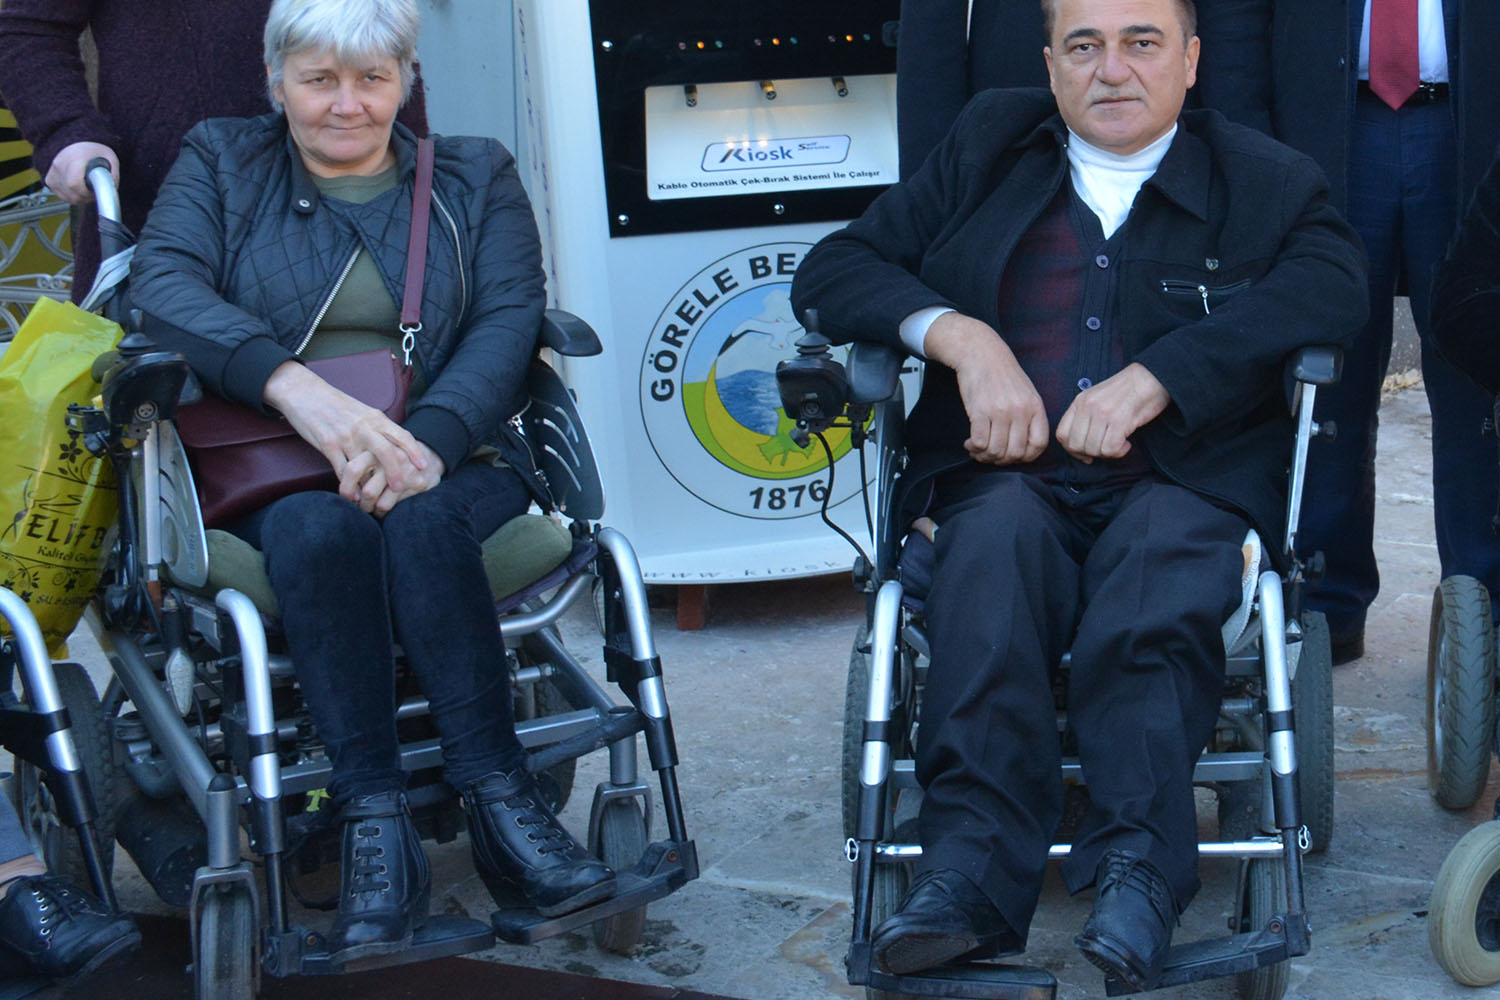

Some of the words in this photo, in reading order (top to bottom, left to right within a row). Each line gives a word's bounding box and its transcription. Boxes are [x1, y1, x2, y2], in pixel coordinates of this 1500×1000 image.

[719, 146, 793, 164] Kiosk
[658, 182, 688, 190] Kablo
[690, 178, 738, 188] Otomatik
[740, 174, 790, 187] Çek-Bırak
[792, 172, 831, 182] Sistemi
[832, 171, 847, 179] İle
[648, 268, 739, 402] GÖRELE
[749, 479, 828, 511] 1876
